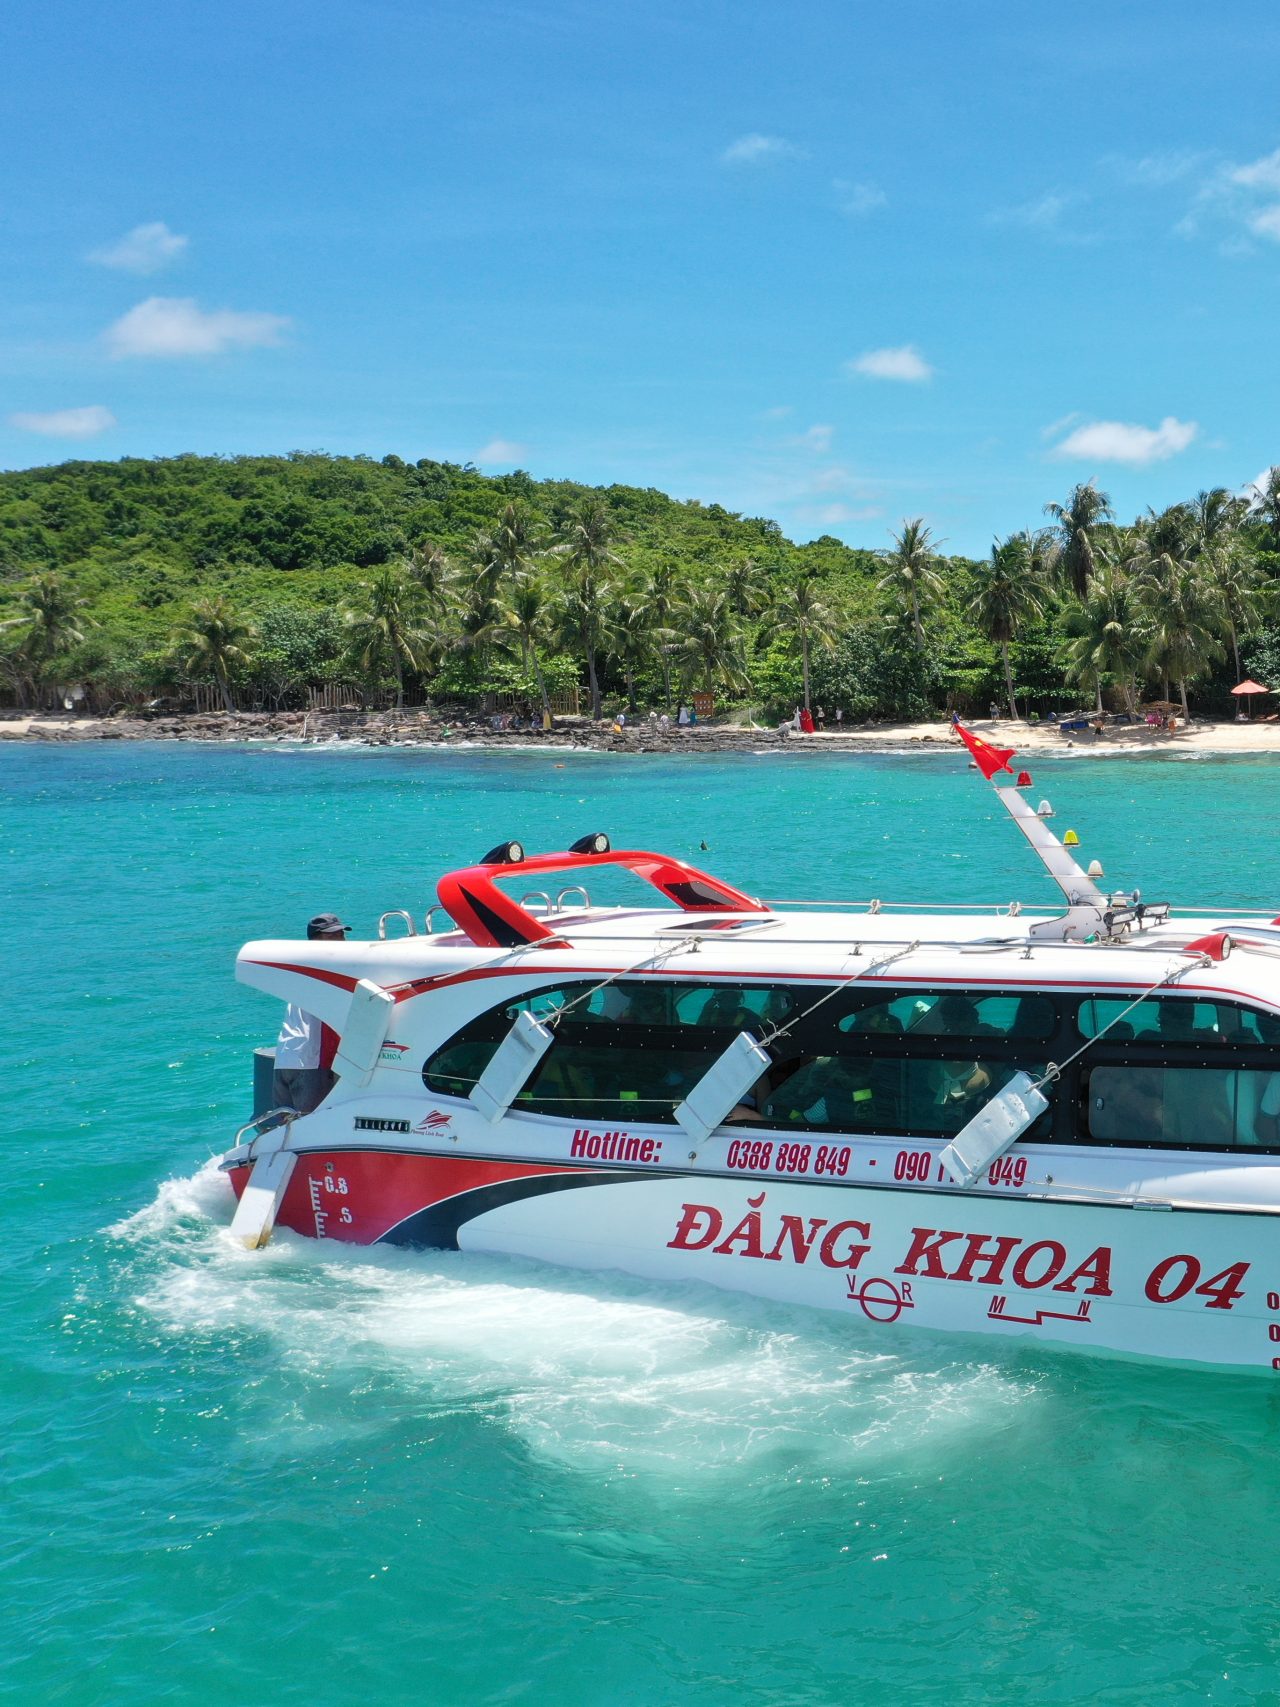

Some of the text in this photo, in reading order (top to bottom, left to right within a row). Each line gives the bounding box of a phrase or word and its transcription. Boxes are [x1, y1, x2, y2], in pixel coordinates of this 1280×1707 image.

[570, 1129, 663, 1162] Hotline:
[726, 1140, 773, 1170] 0388
[775, 1143, 811, 1173] 898
[814, 1145, 851, 1176] 849
[894, 1151, 931, 1181] 090
[988, 1156, 1027, 1187] 049
[666, 1191, 1251, 1310] ĐĂNG KHOA 04
[846, 1274, 913, 1301] V R
[988, 1295, 1092, 1316] M N
